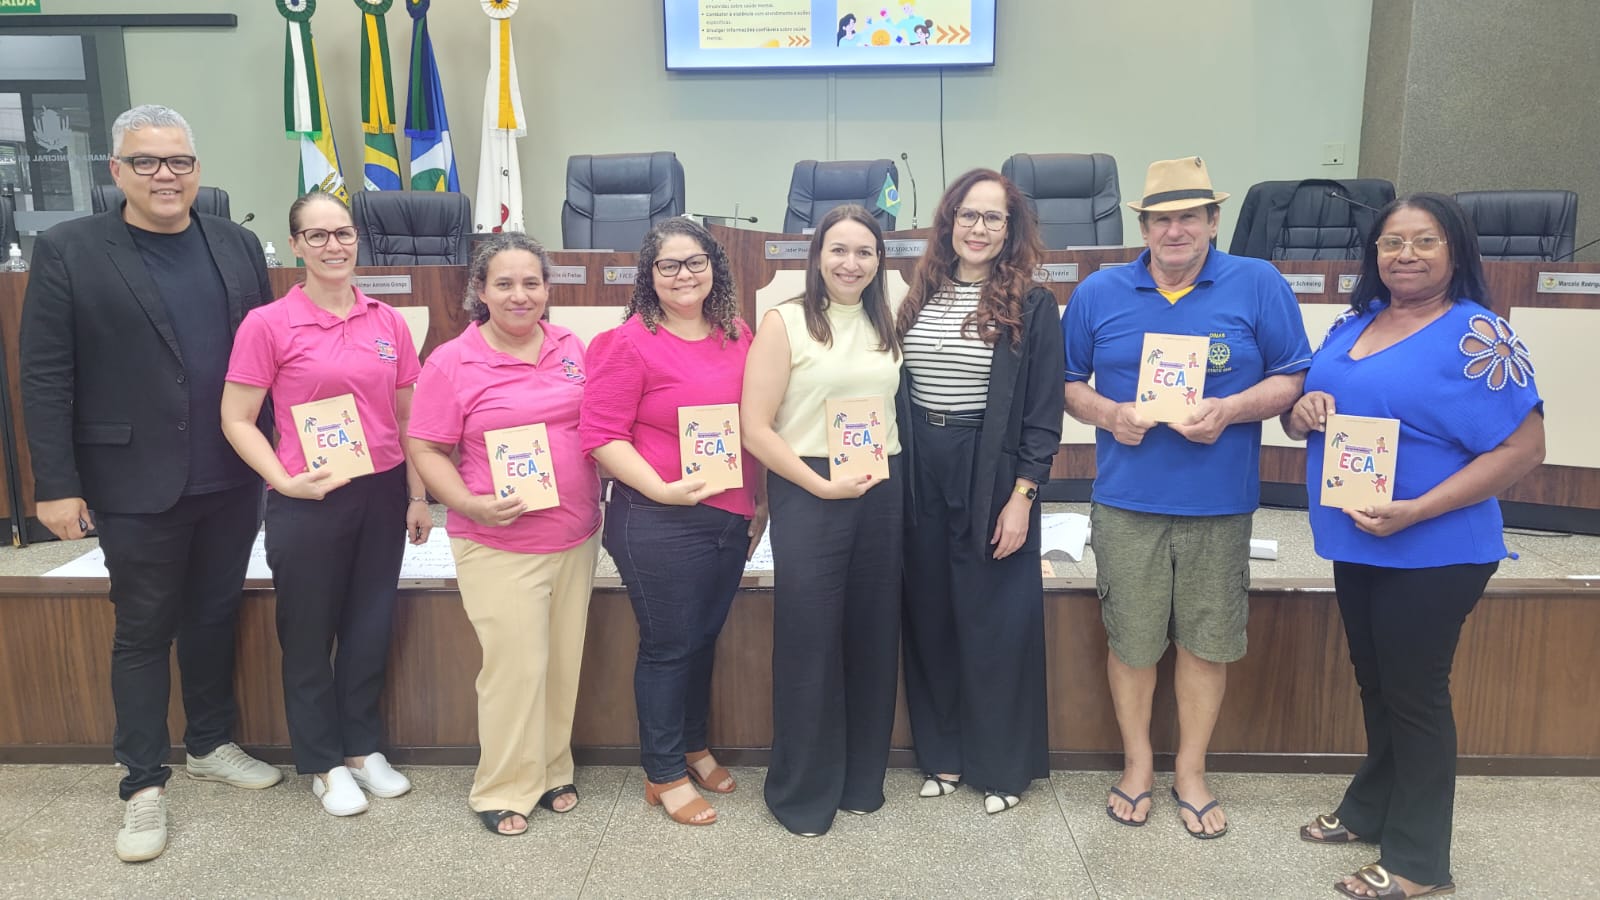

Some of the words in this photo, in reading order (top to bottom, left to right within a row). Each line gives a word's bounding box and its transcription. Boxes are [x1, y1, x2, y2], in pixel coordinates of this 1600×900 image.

[1153, 368, 1186, 387] ECA
[316, 429, 349, 448] ECA
[694, 439, 725, 456] ECA
[843, 430, 872, 447] ECA
[507, 459, 538, 477] ECA
[1339, 452, 1375, 473] ECA
